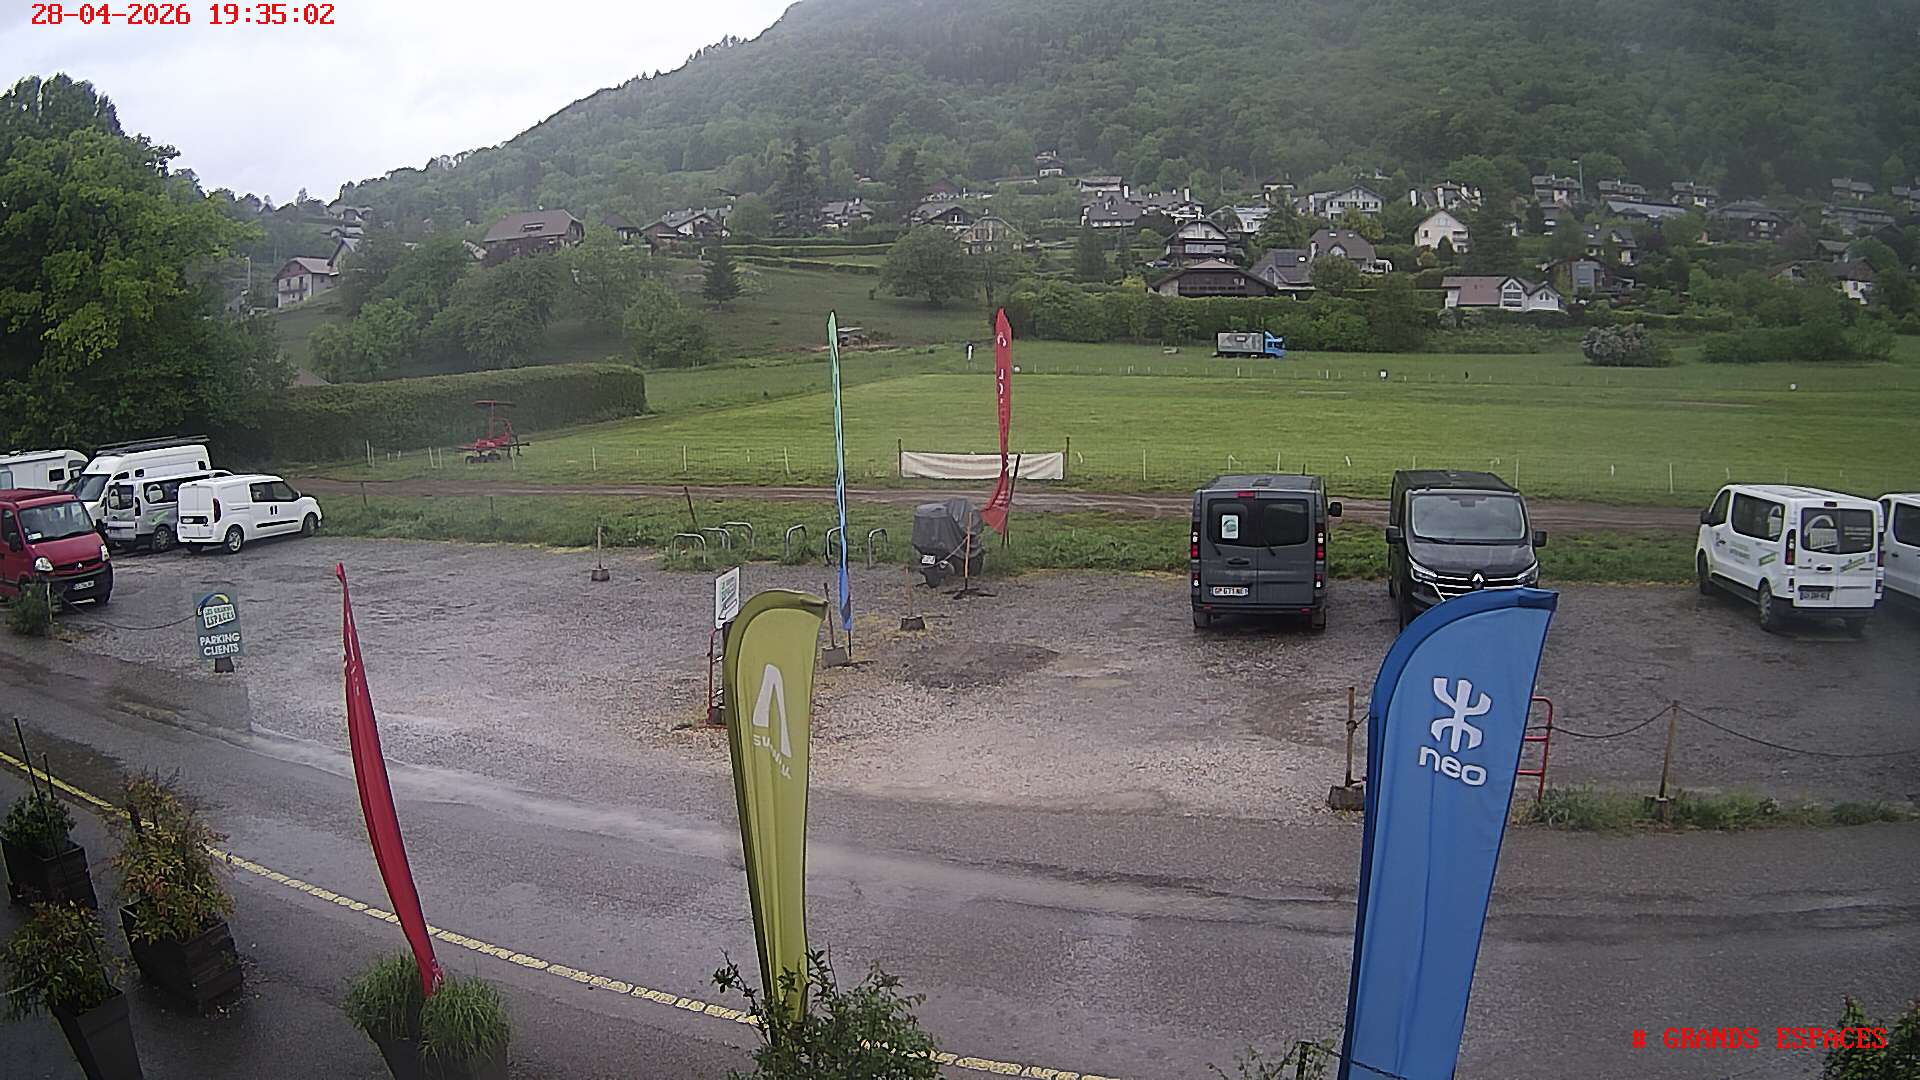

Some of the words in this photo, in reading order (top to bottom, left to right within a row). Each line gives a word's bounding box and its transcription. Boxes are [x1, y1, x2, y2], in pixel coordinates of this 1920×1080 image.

[207, 612, 234, 625] ESPACES
[200, 632, 240, 646] PARKING
[203, 643, 239, 656] CLIENTS
[1419, 746, 1487, 785] neo
